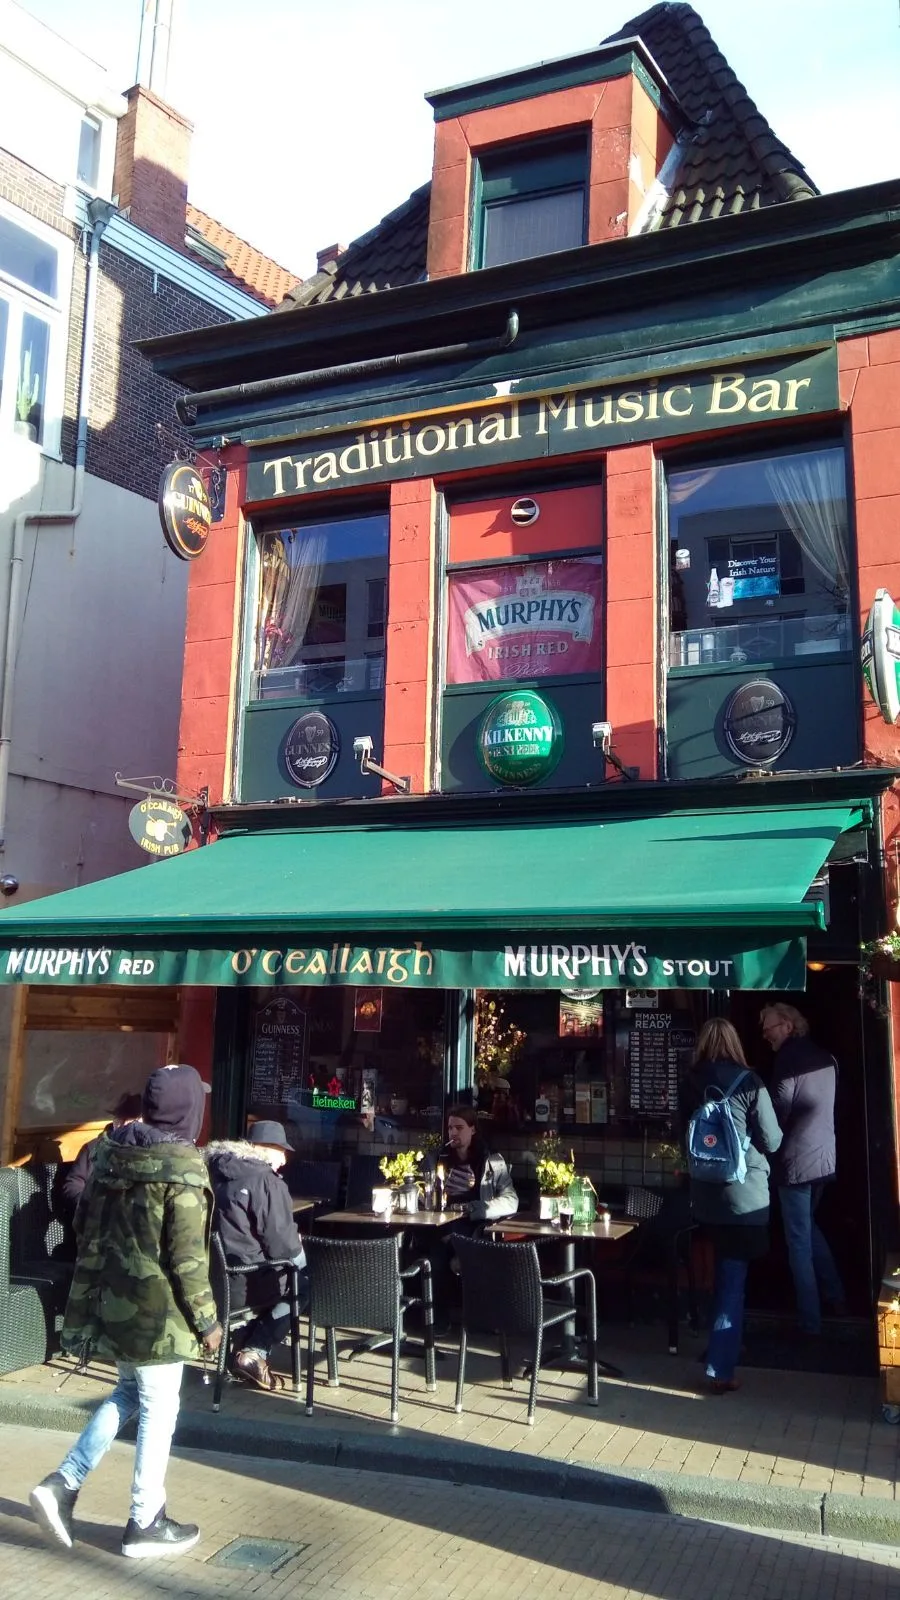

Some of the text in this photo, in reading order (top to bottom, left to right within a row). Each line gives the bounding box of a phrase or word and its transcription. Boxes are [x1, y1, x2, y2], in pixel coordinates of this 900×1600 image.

[263, 371, 811, 496] Traditional Music Bar
[749, 566, 775, 575] Nature
[476, 597, 582, 632] MURPHY'S
[489, 640, 569, 660] IRISH RED
[484, 725, 553, 746] KILKENNY
[285, 742, 340, 756] GUINNESS
[140, 837, 180, 855] IRISH PUB
[6, 945, 155, 976] MURPHY'S RED
[503, 941, 734, 980] MURPHY'S STOUT
[635, 1020, 671, 1029] READY
[642, 1013, 672, 1021] MATCH
[261, 1023, 300, 1035] GUINNESS
[312, 1095, 356, 1110] Heineken
